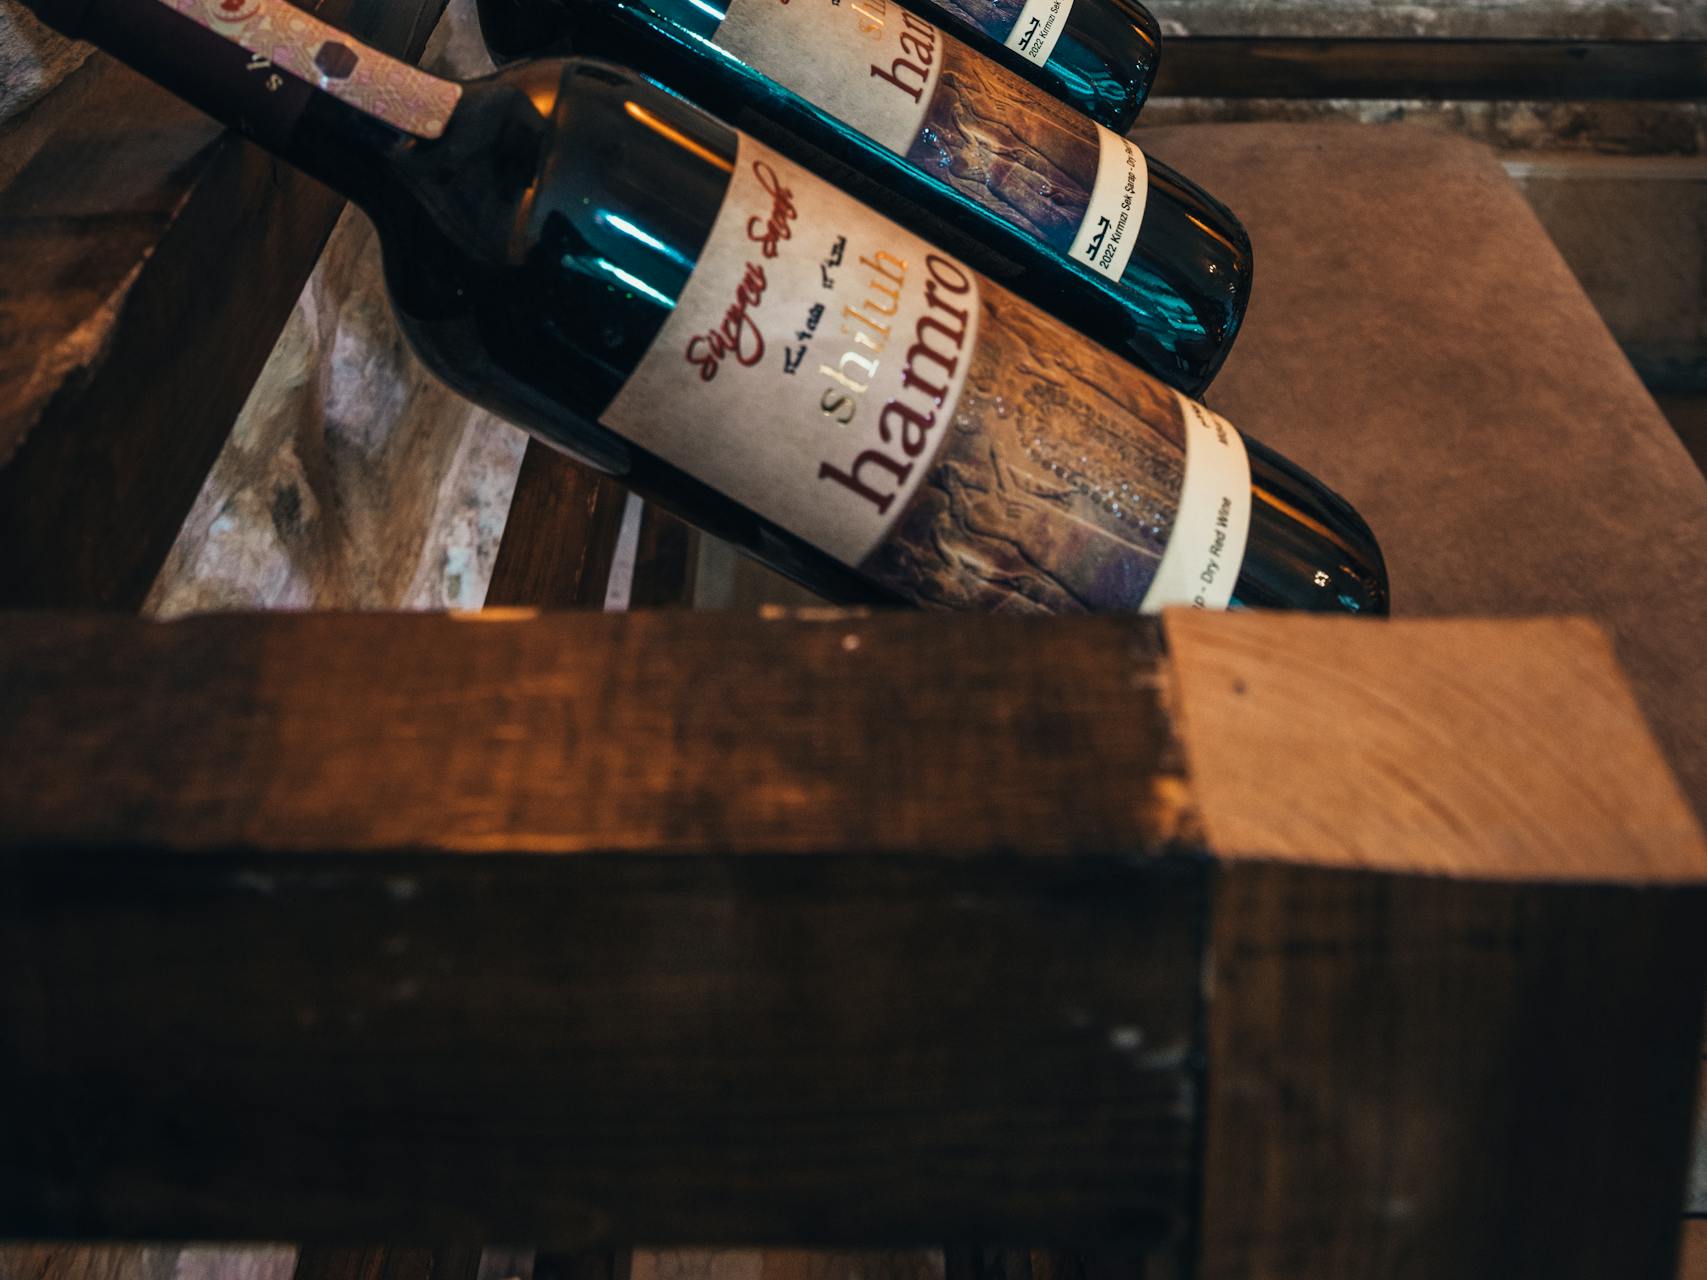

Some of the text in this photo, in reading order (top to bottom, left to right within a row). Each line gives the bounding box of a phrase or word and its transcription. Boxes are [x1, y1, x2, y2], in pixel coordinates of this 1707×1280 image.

[1028, 38, 1045, 58] 2022
[1050, 0, 1062, 14] Sek
[1125, 174, 1137, 195] Şarap
[1121, 195, 1133, 211] Sek
[1111, 212, 1129, 244] Kırmızı
[1099, 243, 1118, 270] 2022
[819, 250, 909, 426] shiluh
[818, 254, 971, 517] hamro
[1209, 528, 1228, 558] Red
[1200, 557, 1221, 585] Dry
